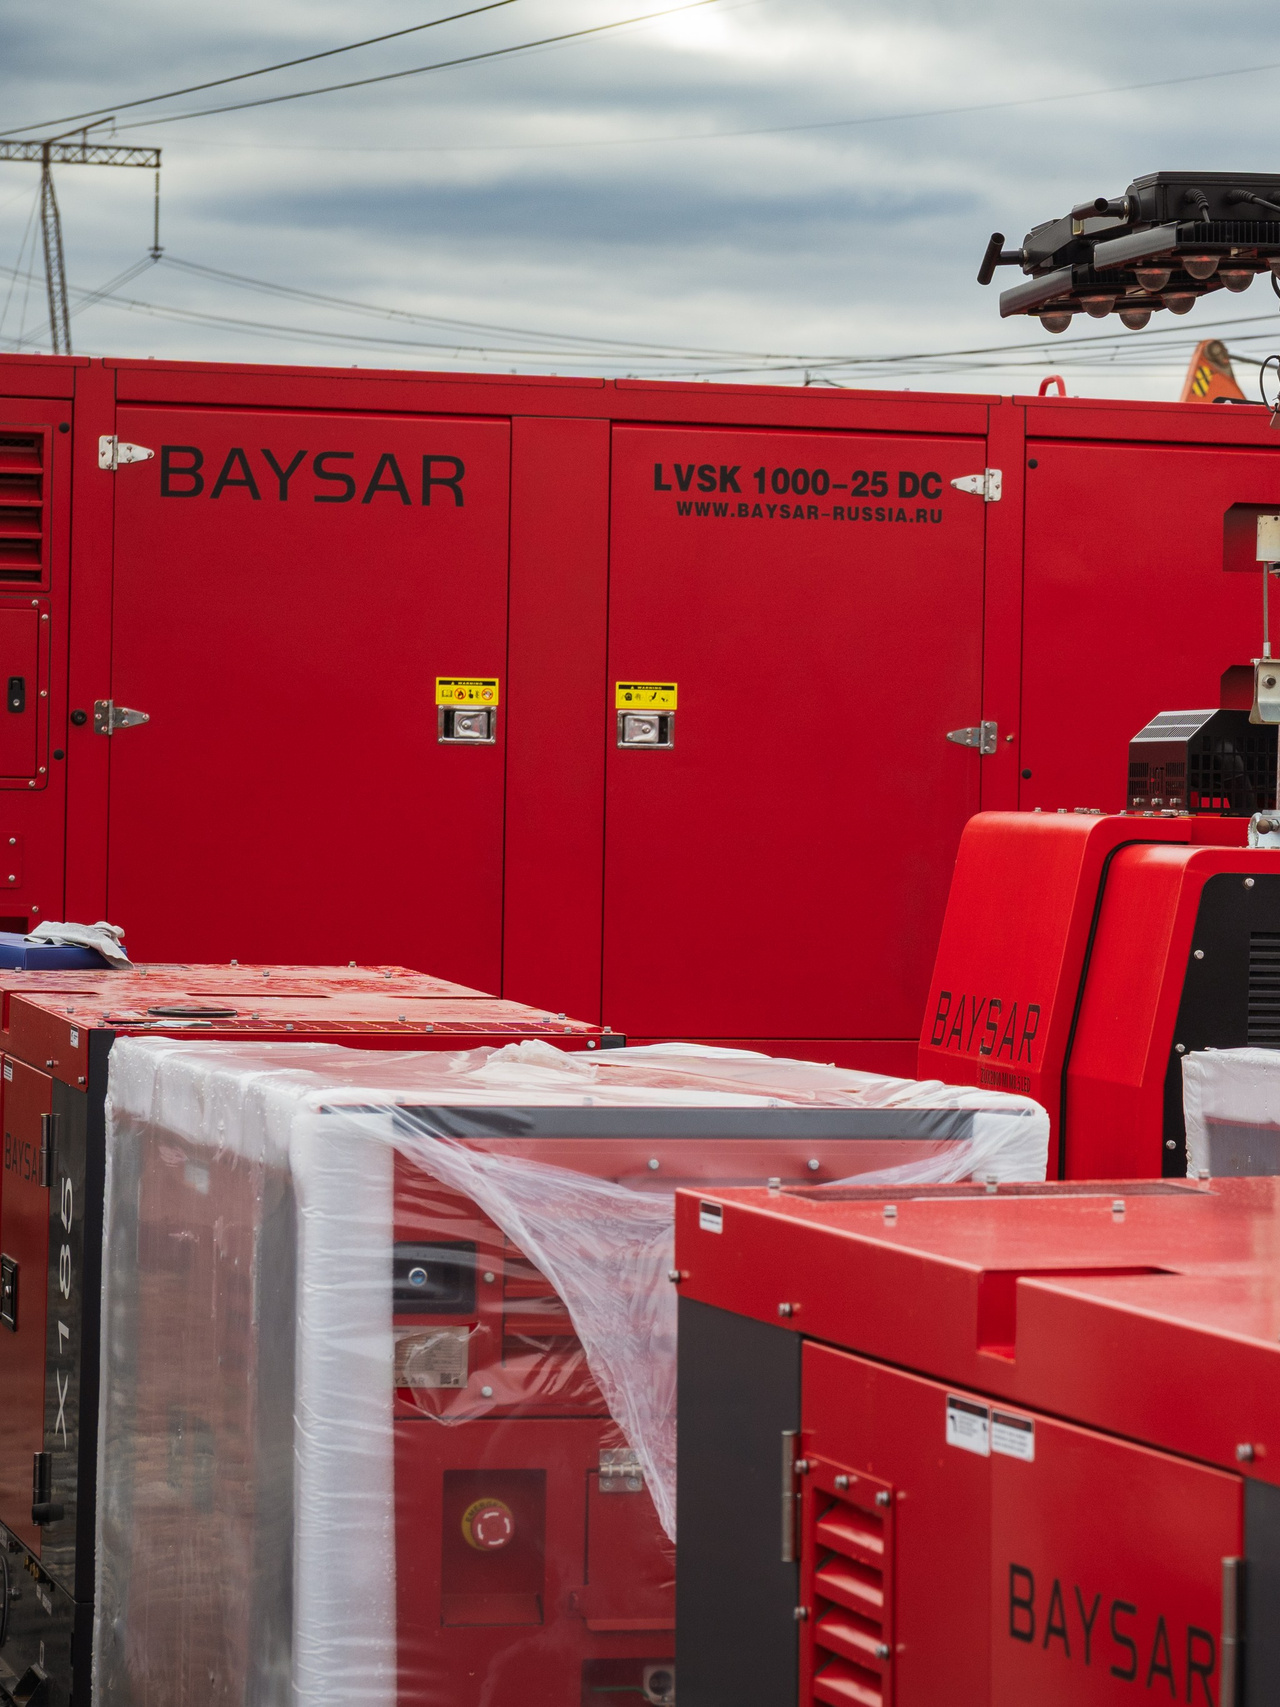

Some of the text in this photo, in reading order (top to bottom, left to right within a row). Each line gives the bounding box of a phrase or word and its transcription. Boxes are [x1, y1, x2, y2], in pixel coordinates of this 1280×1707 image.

[159, 445, 467, 507] BAYSAR
[653, 463, 943, 500] LVSK 1000-25 DC
[676, 501, 943, 524] WWW.BAYSAR-RUSSIA.RU
[930, 990, 1042, 1064] BAYSAR
[1021, 1076, 1031, 1093] LED
[5, 1131, 41, 1186] BAYSA
[55, 1177, 73, 1450] X185
[1009, 1562, 1216, 1707] BAYSAR
